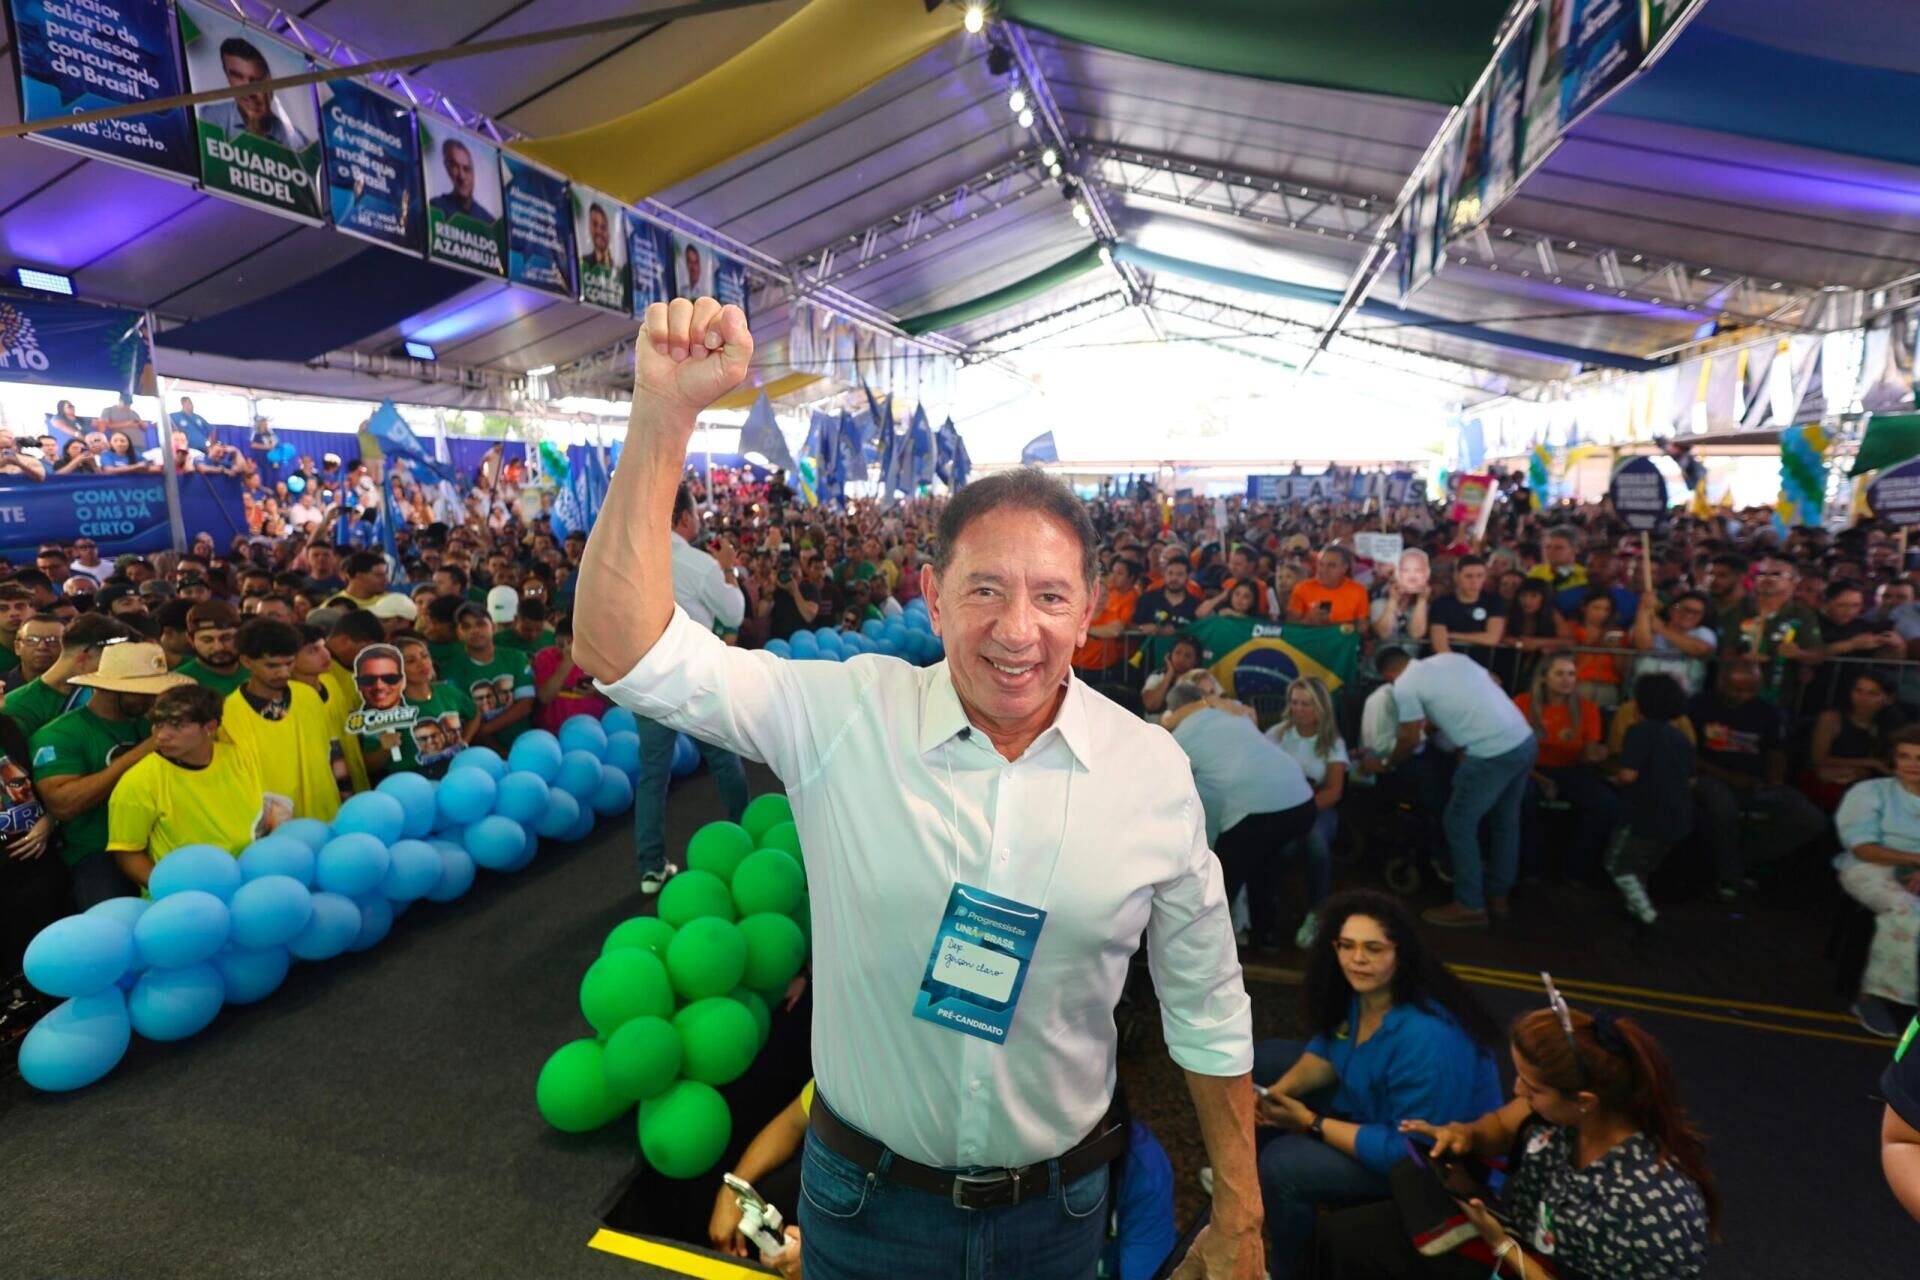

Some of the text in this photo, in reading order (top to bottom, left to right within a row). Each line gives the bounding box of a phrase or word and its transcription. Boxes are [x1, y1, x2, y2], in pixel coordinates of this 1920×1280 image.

[43, 1, 139, 47] salário de
[67, 0, 120, 20] aior
[45, 20, 140, 64] professor
[48, 40, 159, 89] concursado
[51, 56, 145, 99] do Brasil.
[206, 137, 308, 187] EDUARDO
[338, 165, 350, 177] o
[371, 160, 396, 179] que
[229, 166, 295, 204] RIEDEL
[435, 221, 498, 254] REINALDO
[434, 238, 502, 272] AZAMBUJA
[72, 490, 117, 504] COM
[76, 507, 92, 520] O
[96, 505, 123, 519] MS
[80, 521, 135, 536] CERTO
[967, 911, 1027, 936] Progressistas
[983, 932, 1016, 950] BRASIL
[937, 1007, 1004, 1036] PRÉ-CANDIDATO
